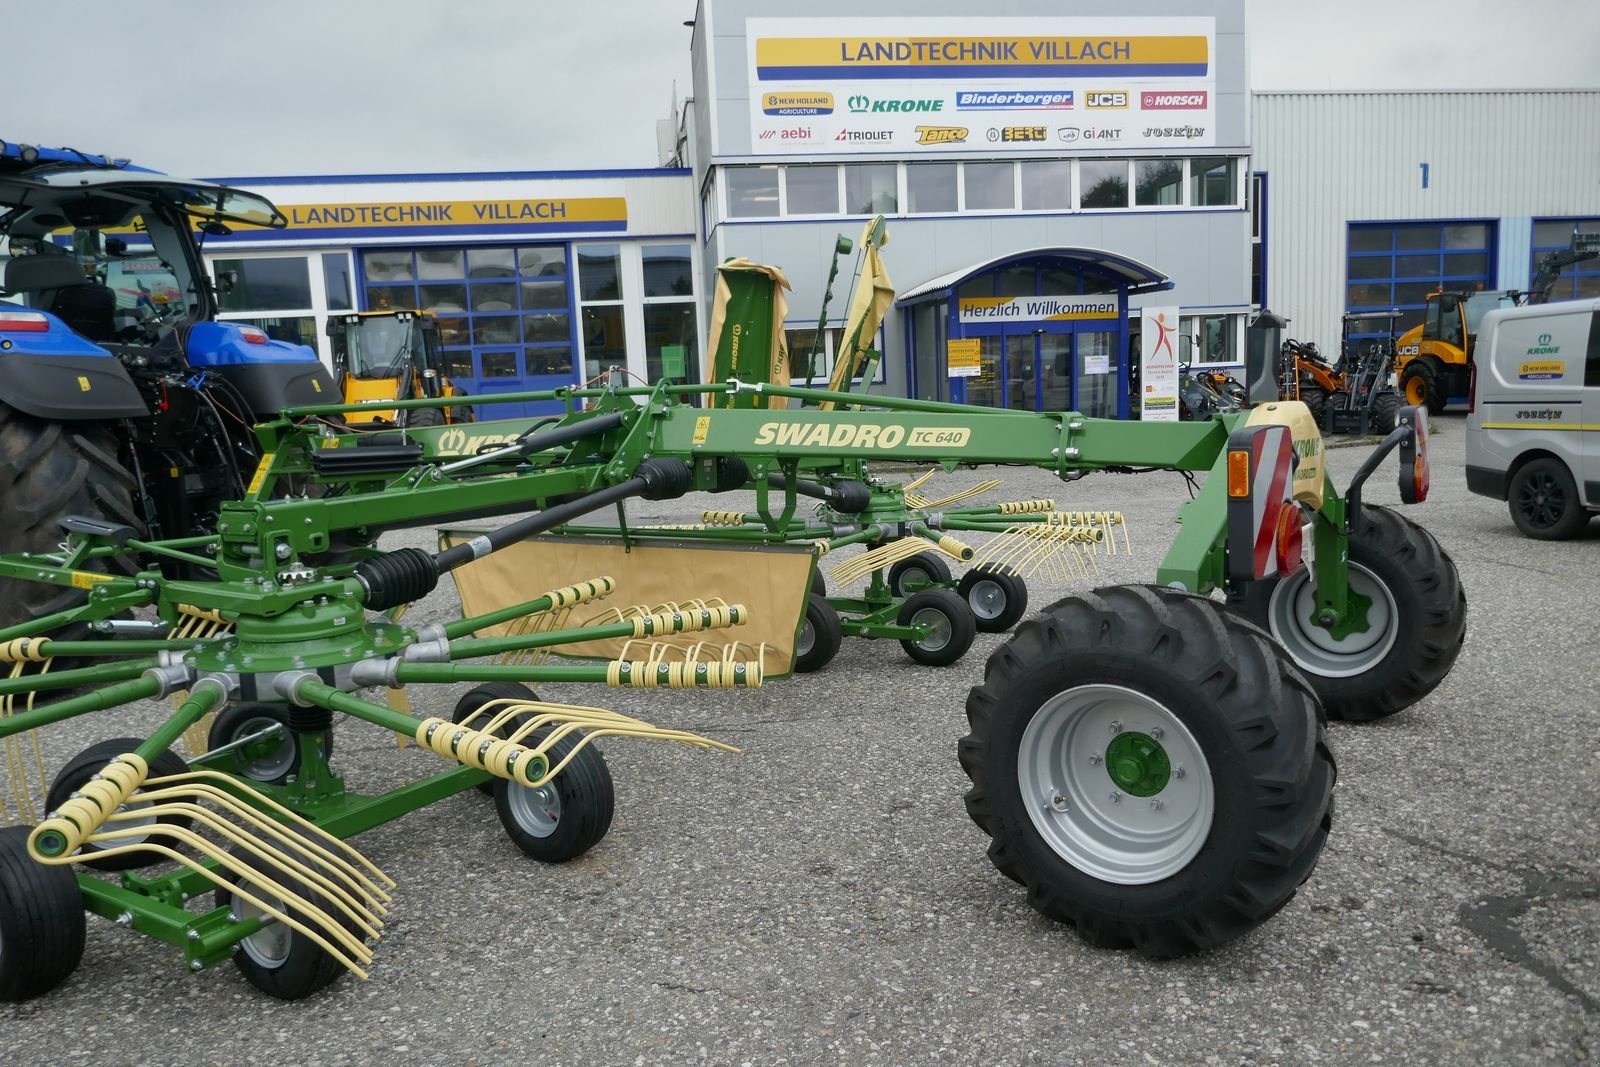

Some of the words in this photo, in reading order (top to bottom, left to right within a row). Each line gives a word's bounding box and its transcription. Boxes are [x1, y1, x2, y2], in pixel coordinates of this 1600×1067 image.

[841, 41, 1018, 62] LANDTECHNIK
[1028, 41, 1130, 61] VILLACH
[871, 99, 944, 113] KRONE
[960, 93, 1071, 106] Binderberger
[1088, 93, 1127, 106] JCB
[1155, 95, 1204, 106] HORSCH
[780, 127, 812, 139] aebi
[847, 130, 894, 141] TRIOLIET
[915, 126, 969, 145] Tanco
[1142, 126, 1205, 139] JOSKIN
[1420, 162, 1429, 189] 1
[292, 205, 453, 225] LANDTECHNIK
[472, 202, 567, 220] VILLACH
[963, 302, 1020, 318] Herzlich
[1026, 301, 1115, 315] Willkommen
[731, 336, 739, 370] KRONE
[1398, 345, 1419, 355] JCB
[1527, 347, 1560, 355] KRONE
[1516, 409, 1562, 420] JOSKIN
[754, 422, 905, 449] SWADRO
[915, 431, 930, 443] TC
[935, 431, 963, 443] 640
